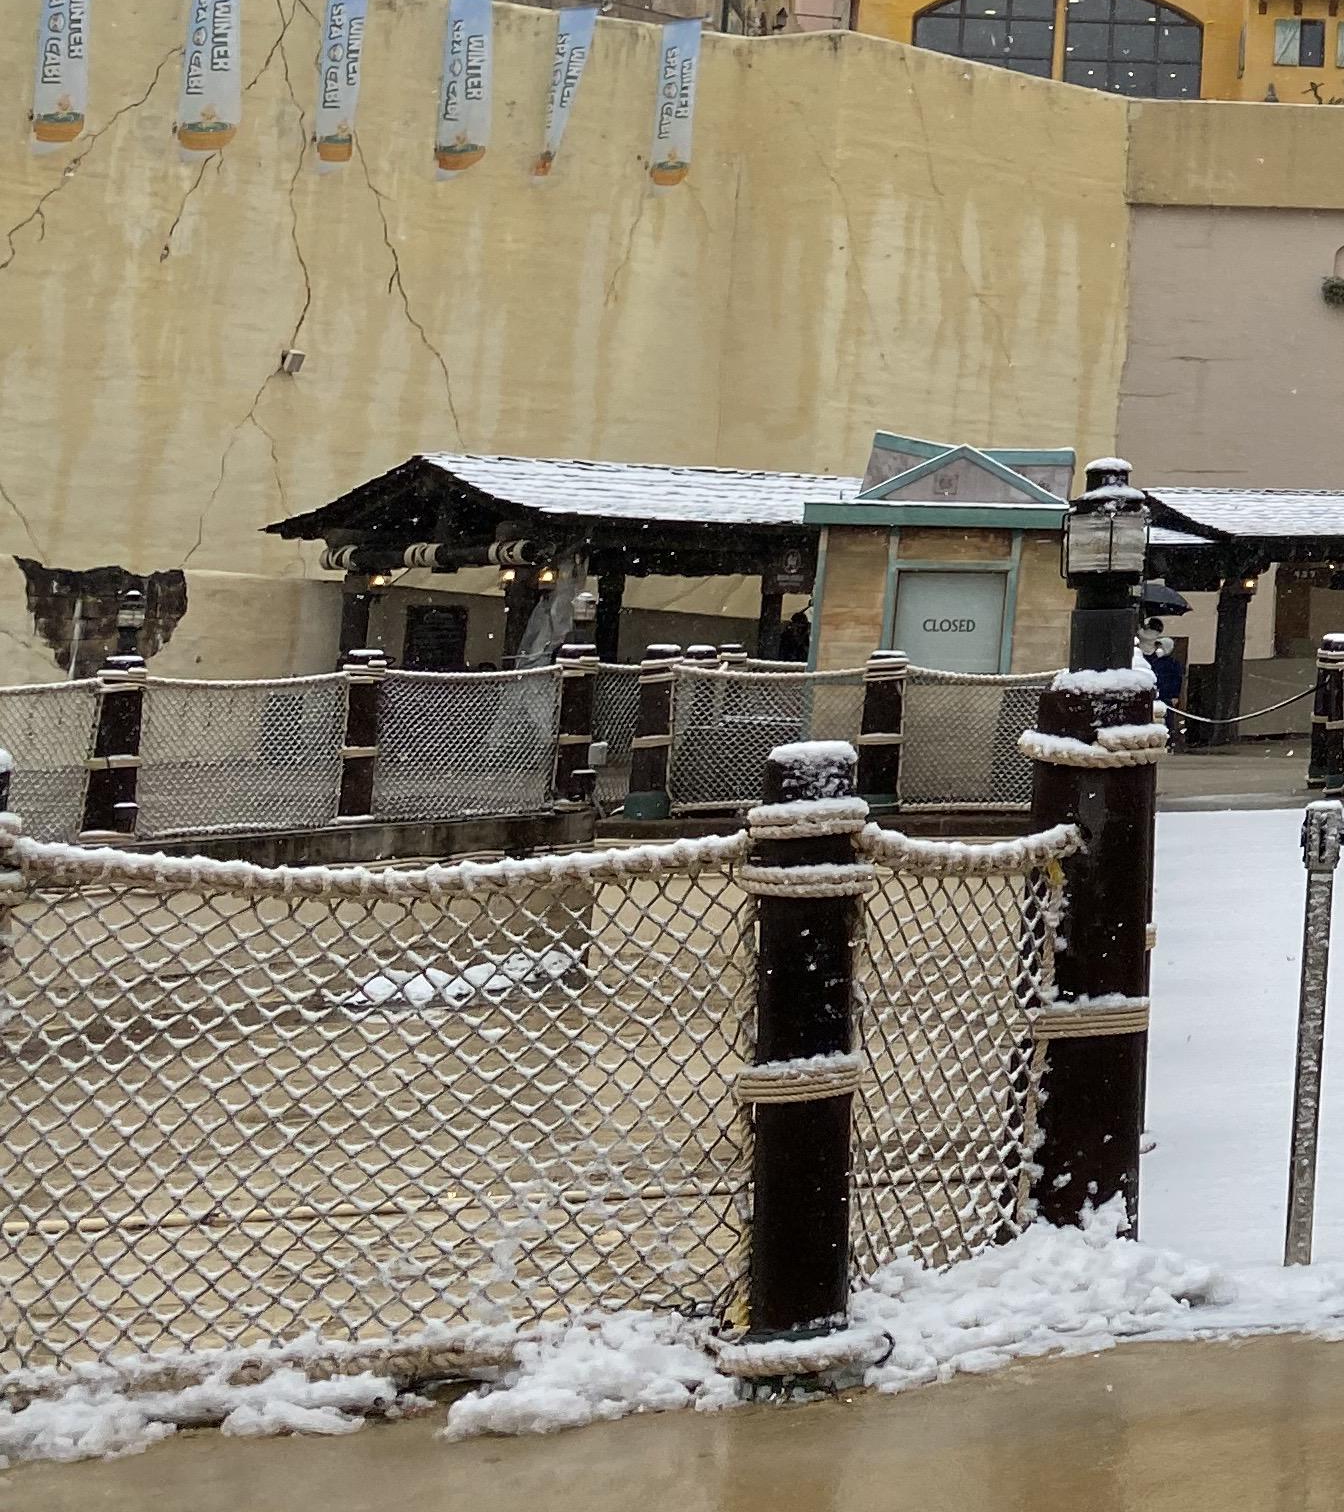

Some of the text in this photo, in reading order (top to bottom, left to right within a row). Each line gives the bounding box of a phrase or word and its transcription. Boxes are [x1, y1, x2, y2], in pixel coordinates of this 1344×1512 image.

[41, 38, 62, 84] CABI
[186, 50, 204, 95] CABI
[323, 3, 344, 109] SPA CABI
[465, 34, 486, 101] WINTER
[664, 46, 680, 80] SPA
[675, 58, 696, 119] WINTER
[923, 619, 976, 633] CLOSED
